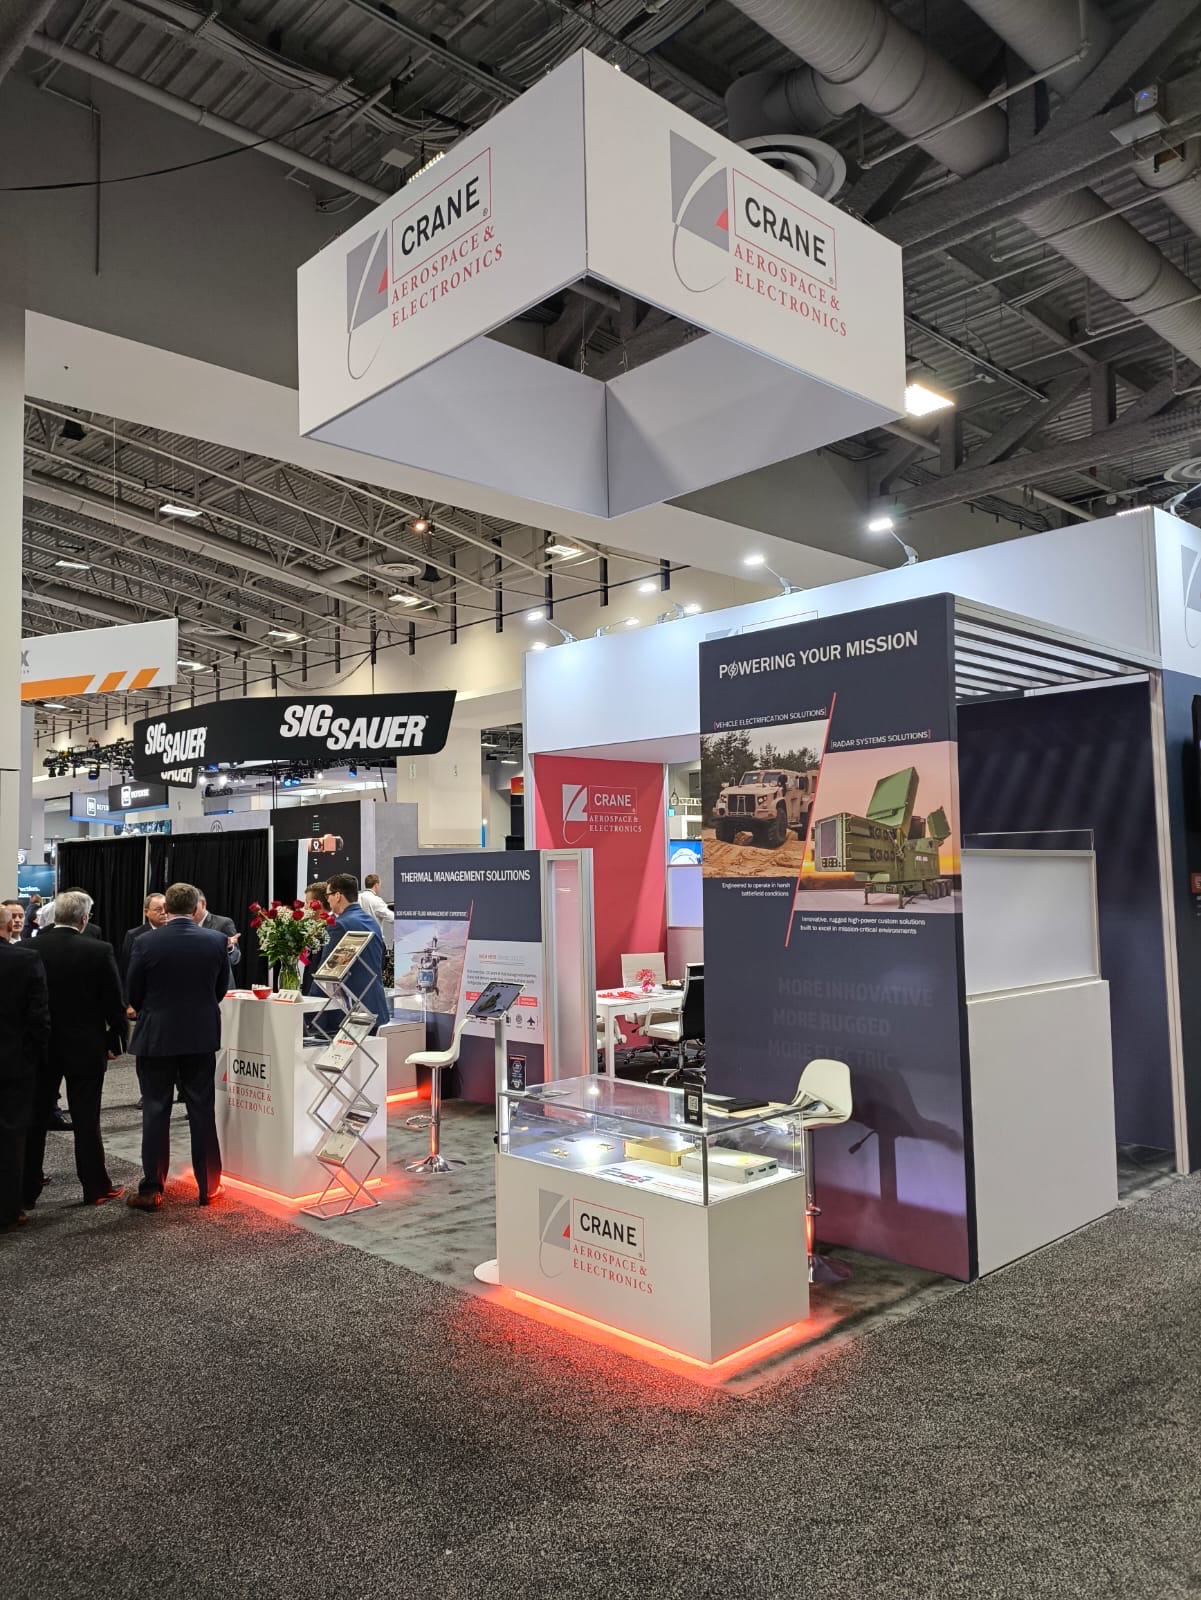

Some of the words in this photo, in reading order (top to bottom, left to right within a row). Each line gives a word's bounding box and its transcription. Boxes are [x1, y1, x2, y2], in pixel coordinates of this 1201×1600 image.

[401, 176, 480, 256] CRANE
[745, 197, 826, 266] CRANE
[391, 233, 479, 304] AEROSPACE
[483, 225, 496, 242] &
[734, 243, 826, 304] AEROSPACE
[830, 295, 840, 311] &
[392, 243, 503, 328] ELECTRONICS
[735, 267, 847, 336] ELECTRONICS
[719, 653, 795, 679] POWERING
[799, 644, 841, 665] YOUR
[846, 630, 918, 658] MISSION
[145, 722, 167, 755] SIG
[162, 727, 207, 764] SAUER
[279, 704, 334, 738] SIG
[326, 715, 427, 750] SAUER
[856, 735, 886, 746] SYSTEMS
[594, 793, 632, 807] CRANE
[589, 815, 633, 823] AEROSPACE
[589, 824, 642, 833] ELECTRONICS
[400, 872, 432, 883] THERMAL
[433, 870, 485, 882] MANAGEMENT
[486, 869, 531, 881] SOLUTIONS
[777, 977, 822, 998] MORE
[825, 979, 935, 1007] INNOVATIVE
[772, 1008, 818, 1029] MORE
[820, 1011, 891, 1037] RUGGED
[768, 1039, 812, 1060] MORE
[233, 1059, 266, 1080] CRANE
[228, 1085, 266, 1101] AEROSPACE
[267, 1094, 272, 1102] &
[228, 1097, 275, 1116] ELECTRONICS
[580, 1212, 637, 1247] CRANE
[573, 1244, 637, 1272] AEROSPACE
[639, 1265, 647, 1276] &
[573, 1258, 653, 1294] ELECTRONICS
